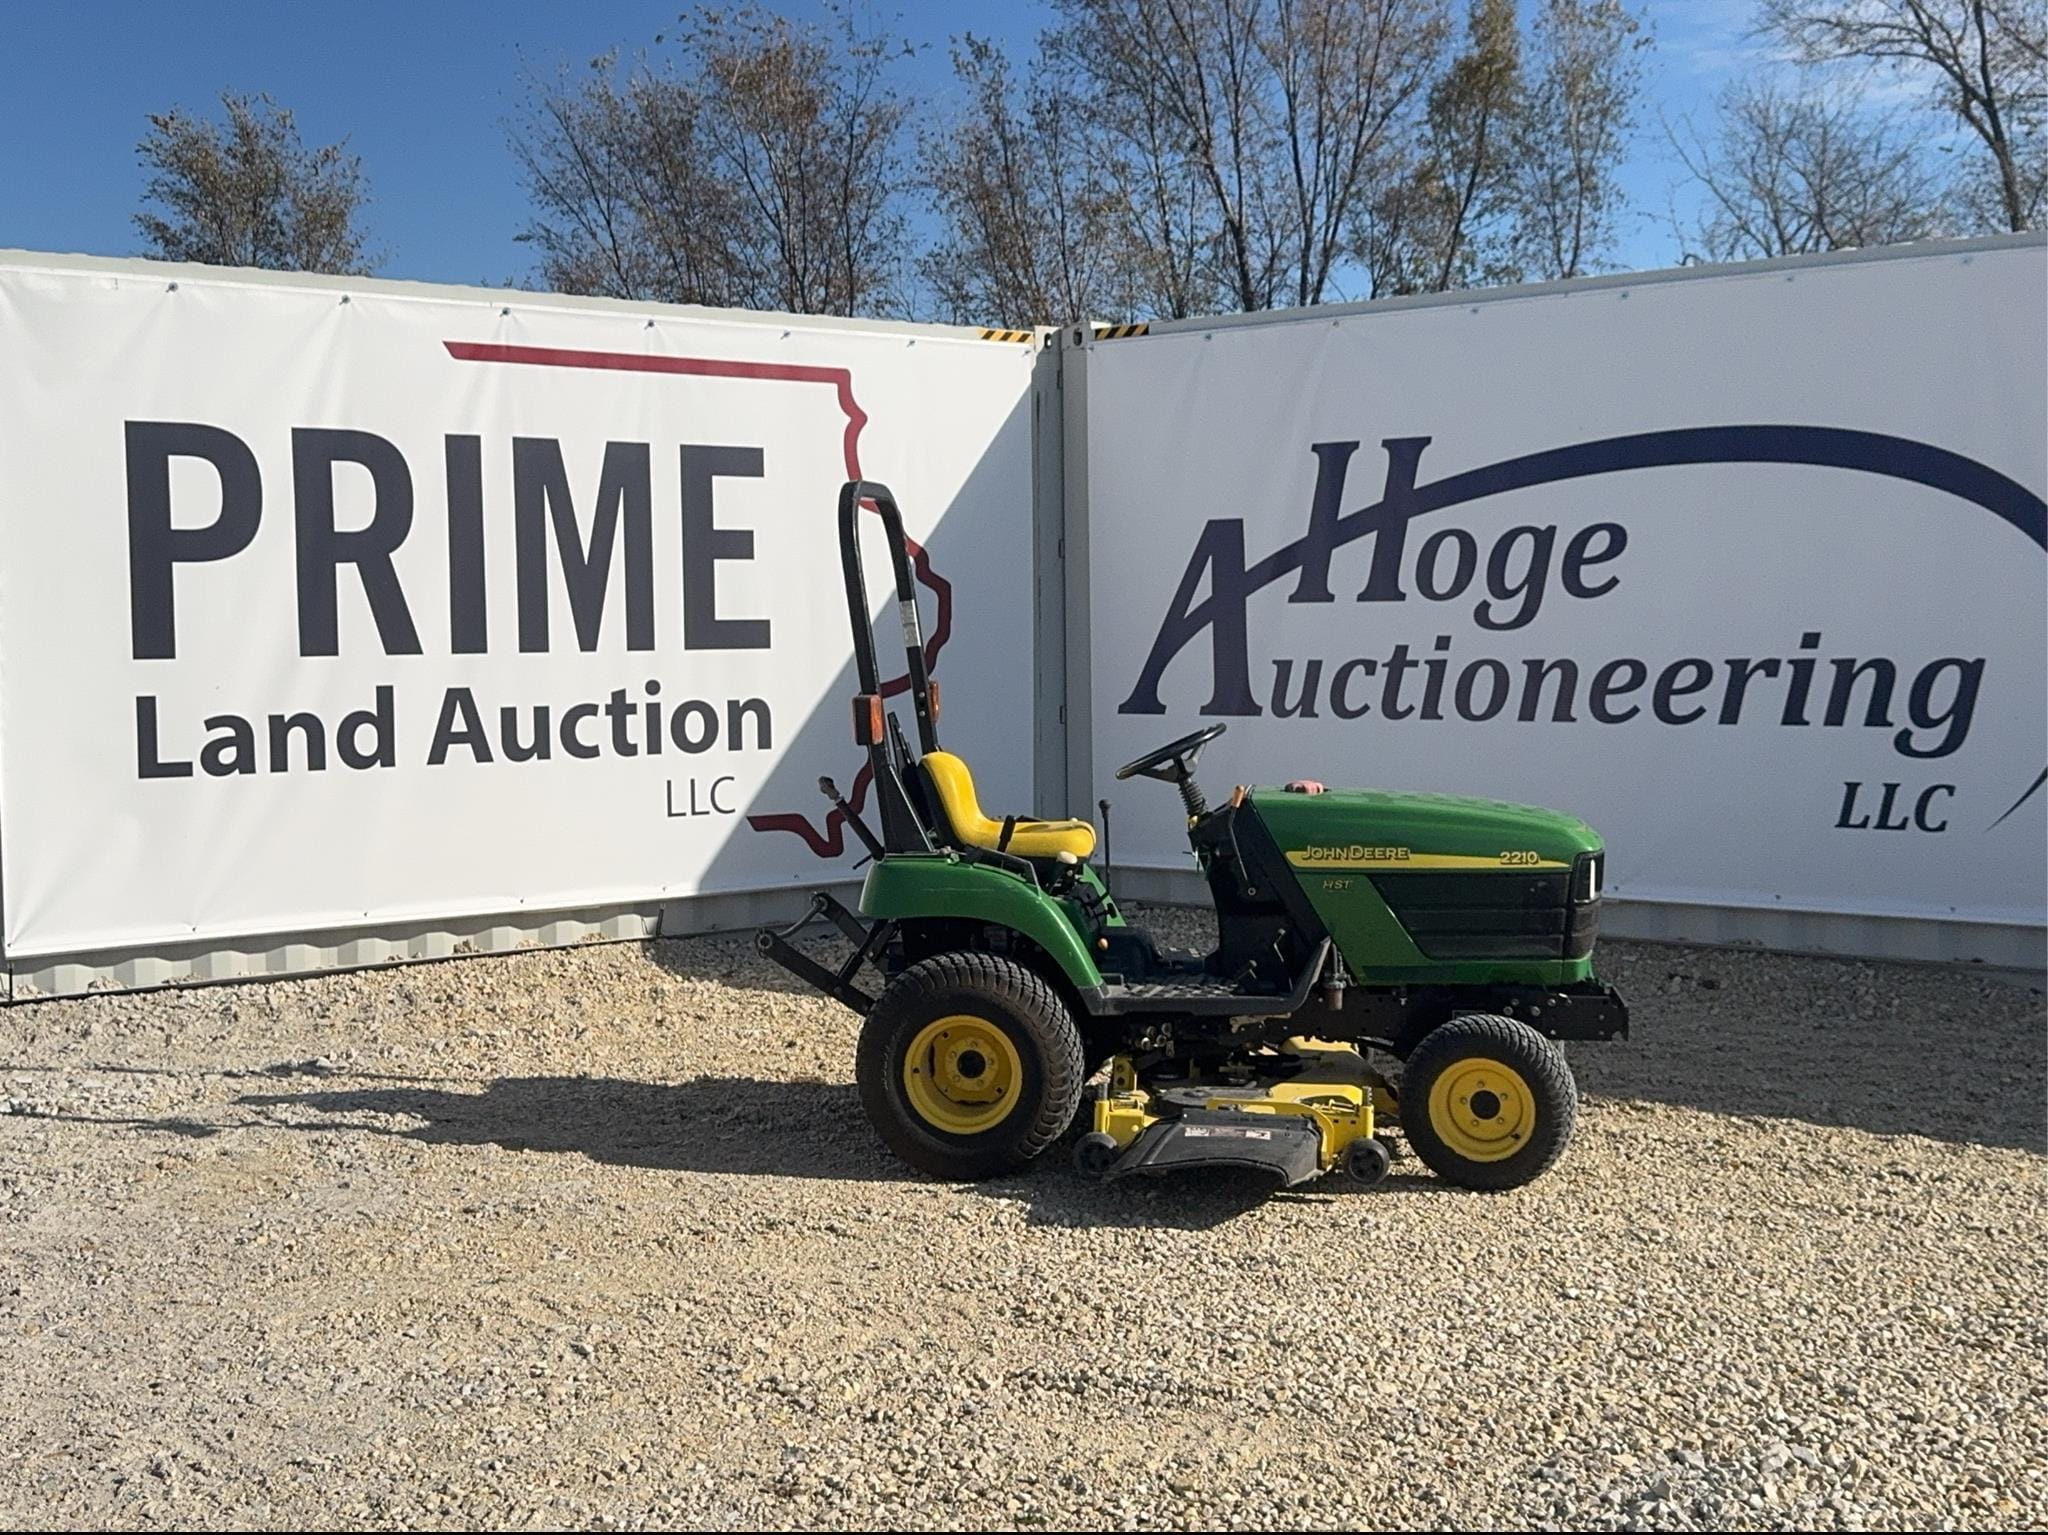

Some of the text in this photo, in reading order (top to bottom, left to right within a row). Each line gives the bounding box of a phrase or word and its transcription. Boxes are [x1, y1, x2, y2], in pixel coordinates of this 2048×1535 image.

[124, 420, 771, 660] PRIME
[1287, 436, 1629, 631] Hoge
[1118, 518, 1987, 759] Auctioneering
[135, 679, 773, 780] Land Auction
[665, 776, 736, 818] LLC
[1835, 782, 1956, 833] LLC
[1302, 845, 1409, 860] JOHN DEERE
[1499, 851, 1539, 865] 2210
[1323, 879, 1352, 889] HST
